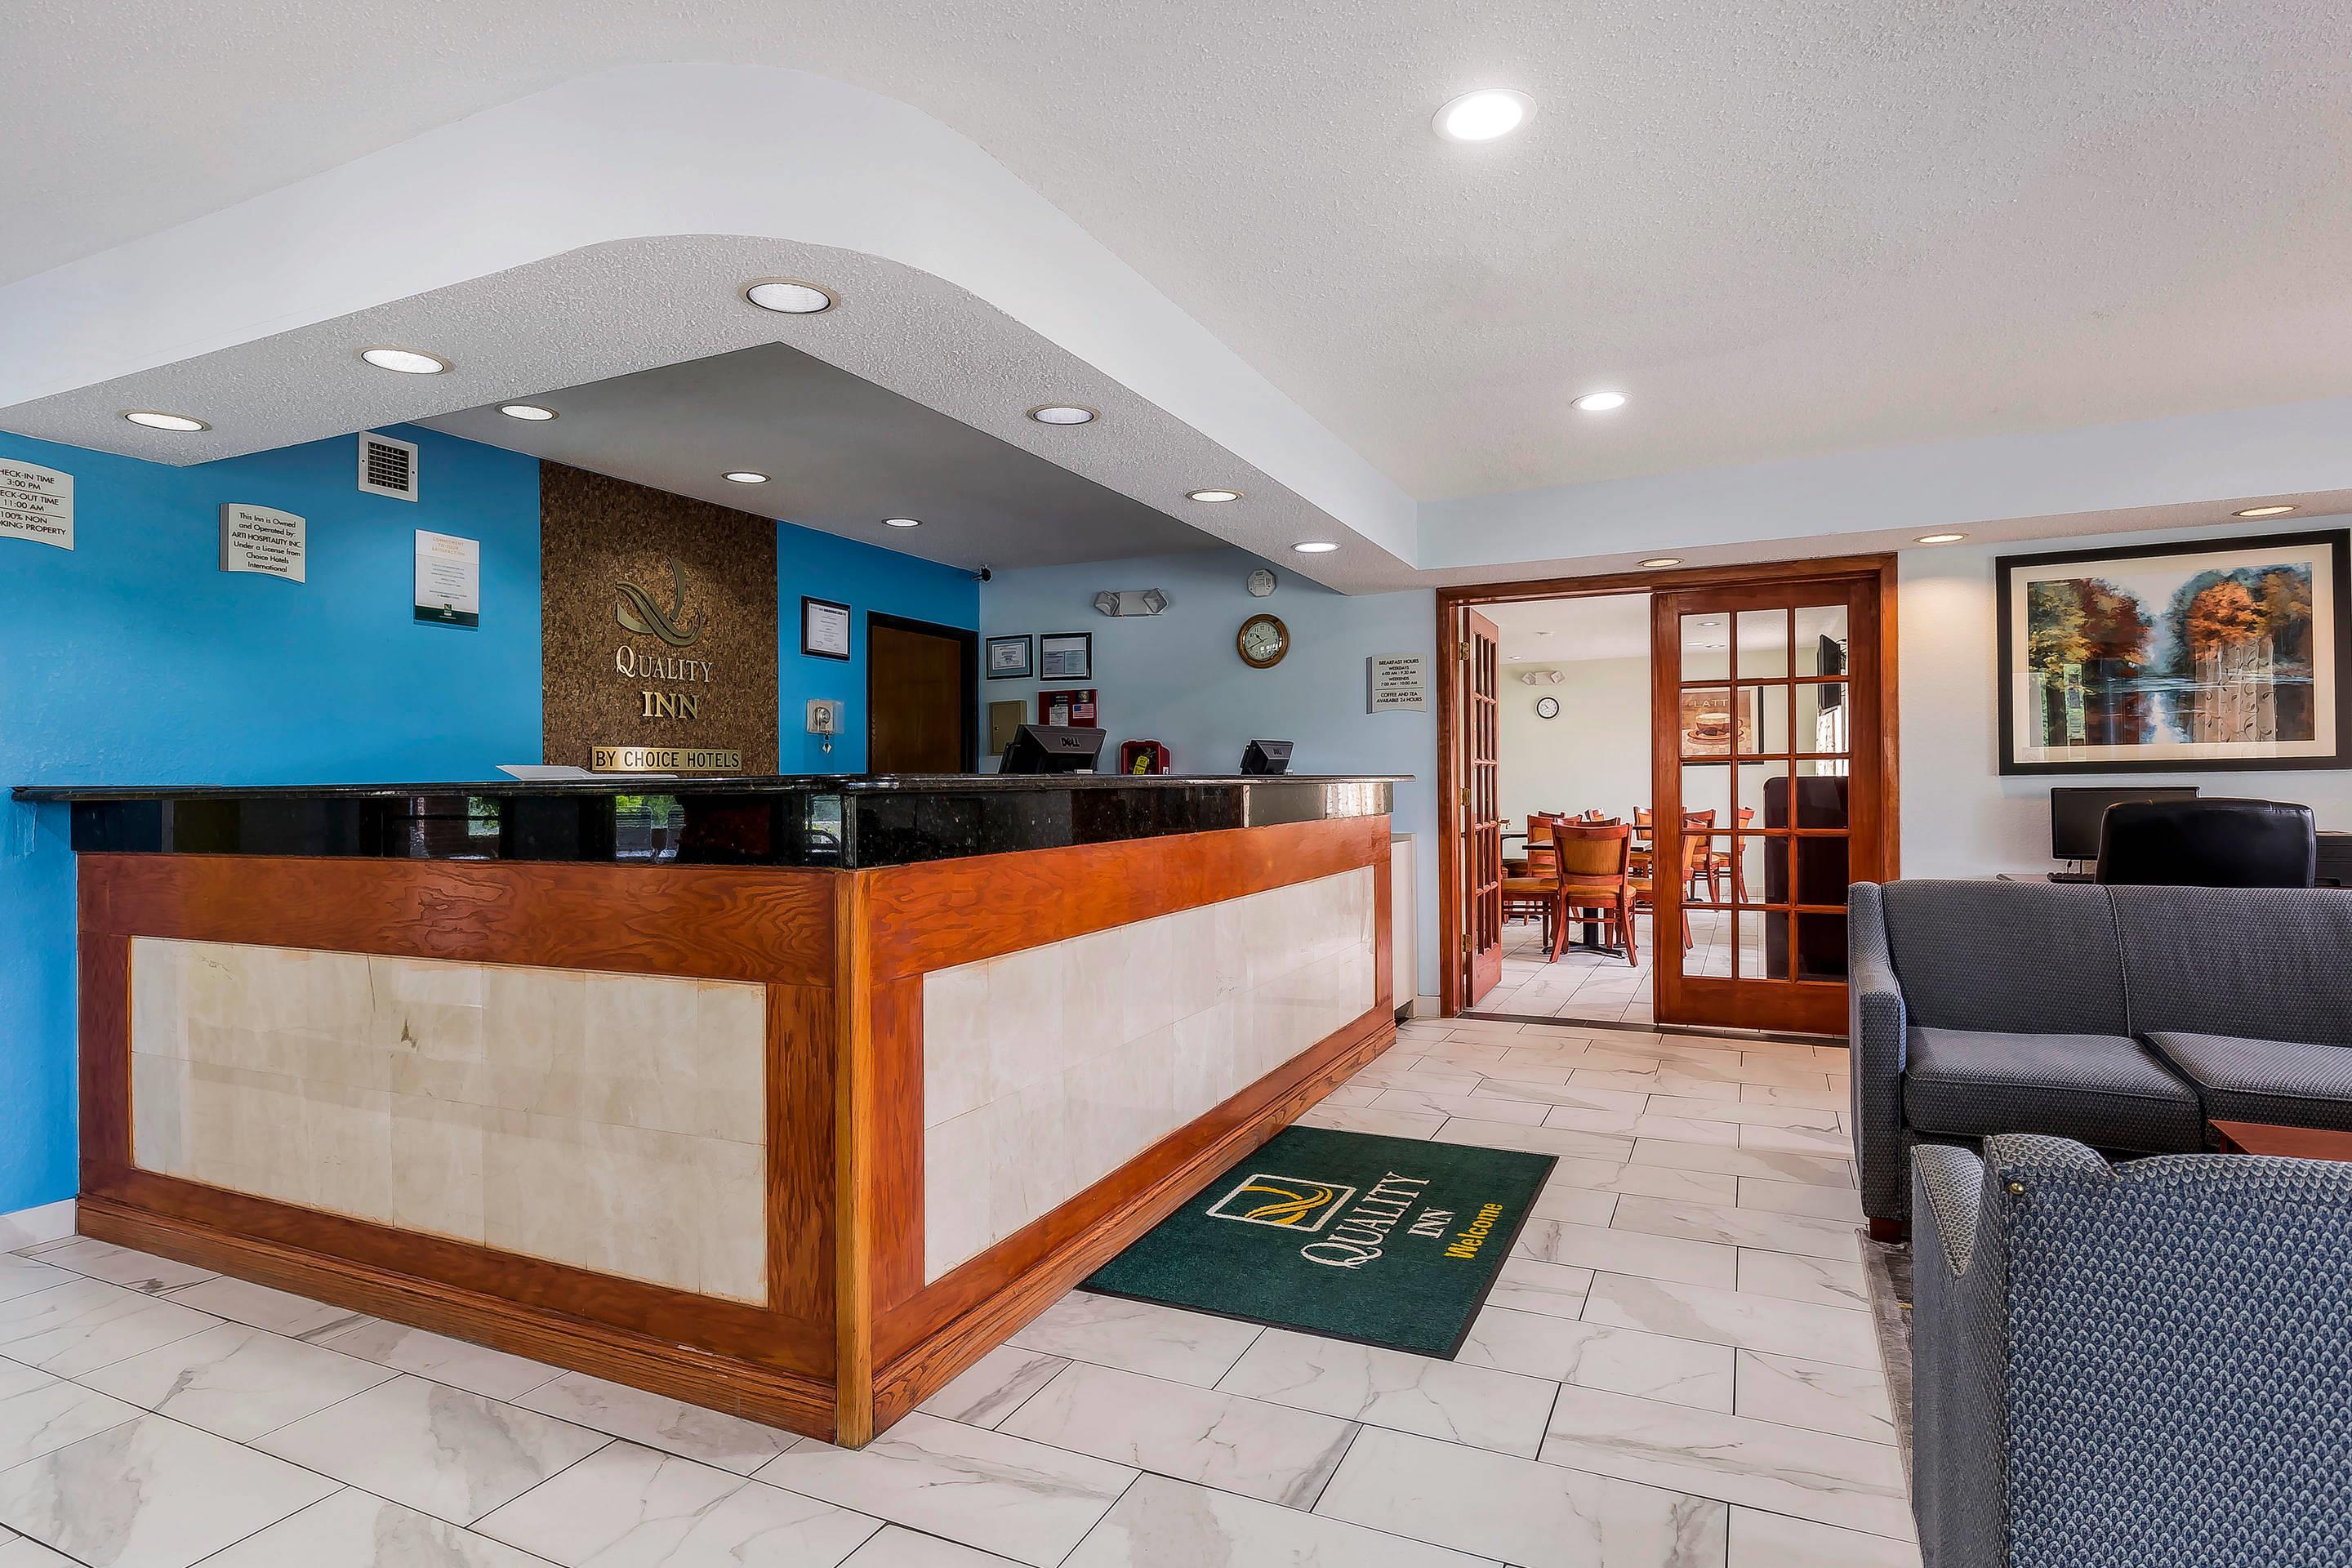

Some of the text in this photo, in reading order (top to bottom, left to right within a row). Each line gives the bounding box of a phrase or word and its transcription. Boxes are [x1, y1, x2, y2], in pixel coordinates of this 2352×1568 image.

[7, 479, 25, 488] 3:00
[37, 474, 55, 484] TIME
[3, 499, 44, 512] 11:00 AM
[41, 496, 59, 506] TIME
[1, 511, 47, 524] 100% NON
[239, 512, 252, 521] This
[273, 519, 296, 528] Owned
[0, 520, 66, 535] KING PROPERTY
[253, 524, 284, 536] Operated
[231, 531, 246, 540] ARTI
[247, 534, 287, 546] HOSPITALITY
[234, 541, 254, 550] Under
[262, 545, 284, 555] License
[286, 548, 301, 557] from
[246, 552, 289, 564] Choice Hotels
[247, 561, 287, 572] International
[615, 645, 713, 683] QUALITY
[641, 691, 700, 719] INN
[1694, 699, 1729, 707] LATT
[1060, 737, 1080, 747] DELL
[595, 751, 740, 768] BY CHOICE HOTELS
[1300, 1170, 1432, 1270] QUALITY
[1407, 1206, 1457, 1240] INN
[1443, 1202, 1503, 1261] Welcome
